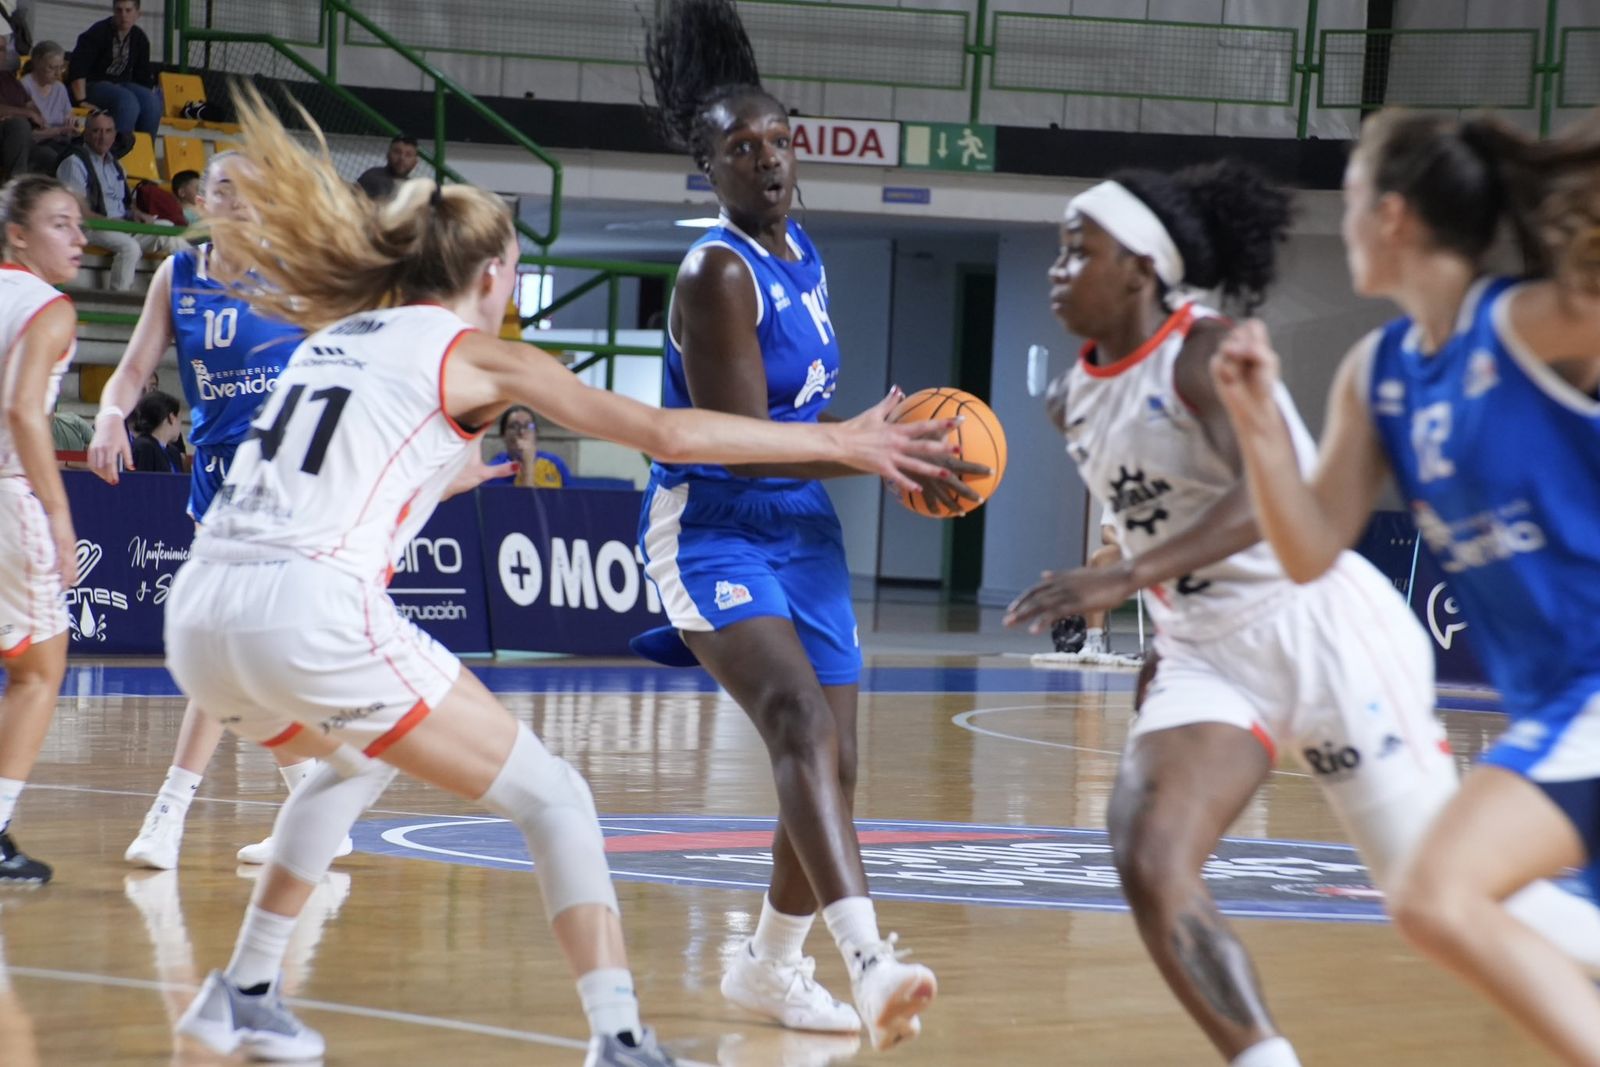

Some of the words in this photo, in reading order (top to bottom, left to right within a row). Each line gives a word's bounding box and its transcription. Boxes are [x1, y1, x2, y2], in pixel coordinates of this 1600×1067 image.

[791, 123, 885, 159] AIDA
[203, 307, 238, 350] 10
[64, 587, 129, 610] ones
[396, 600, 468, 620] strucción
